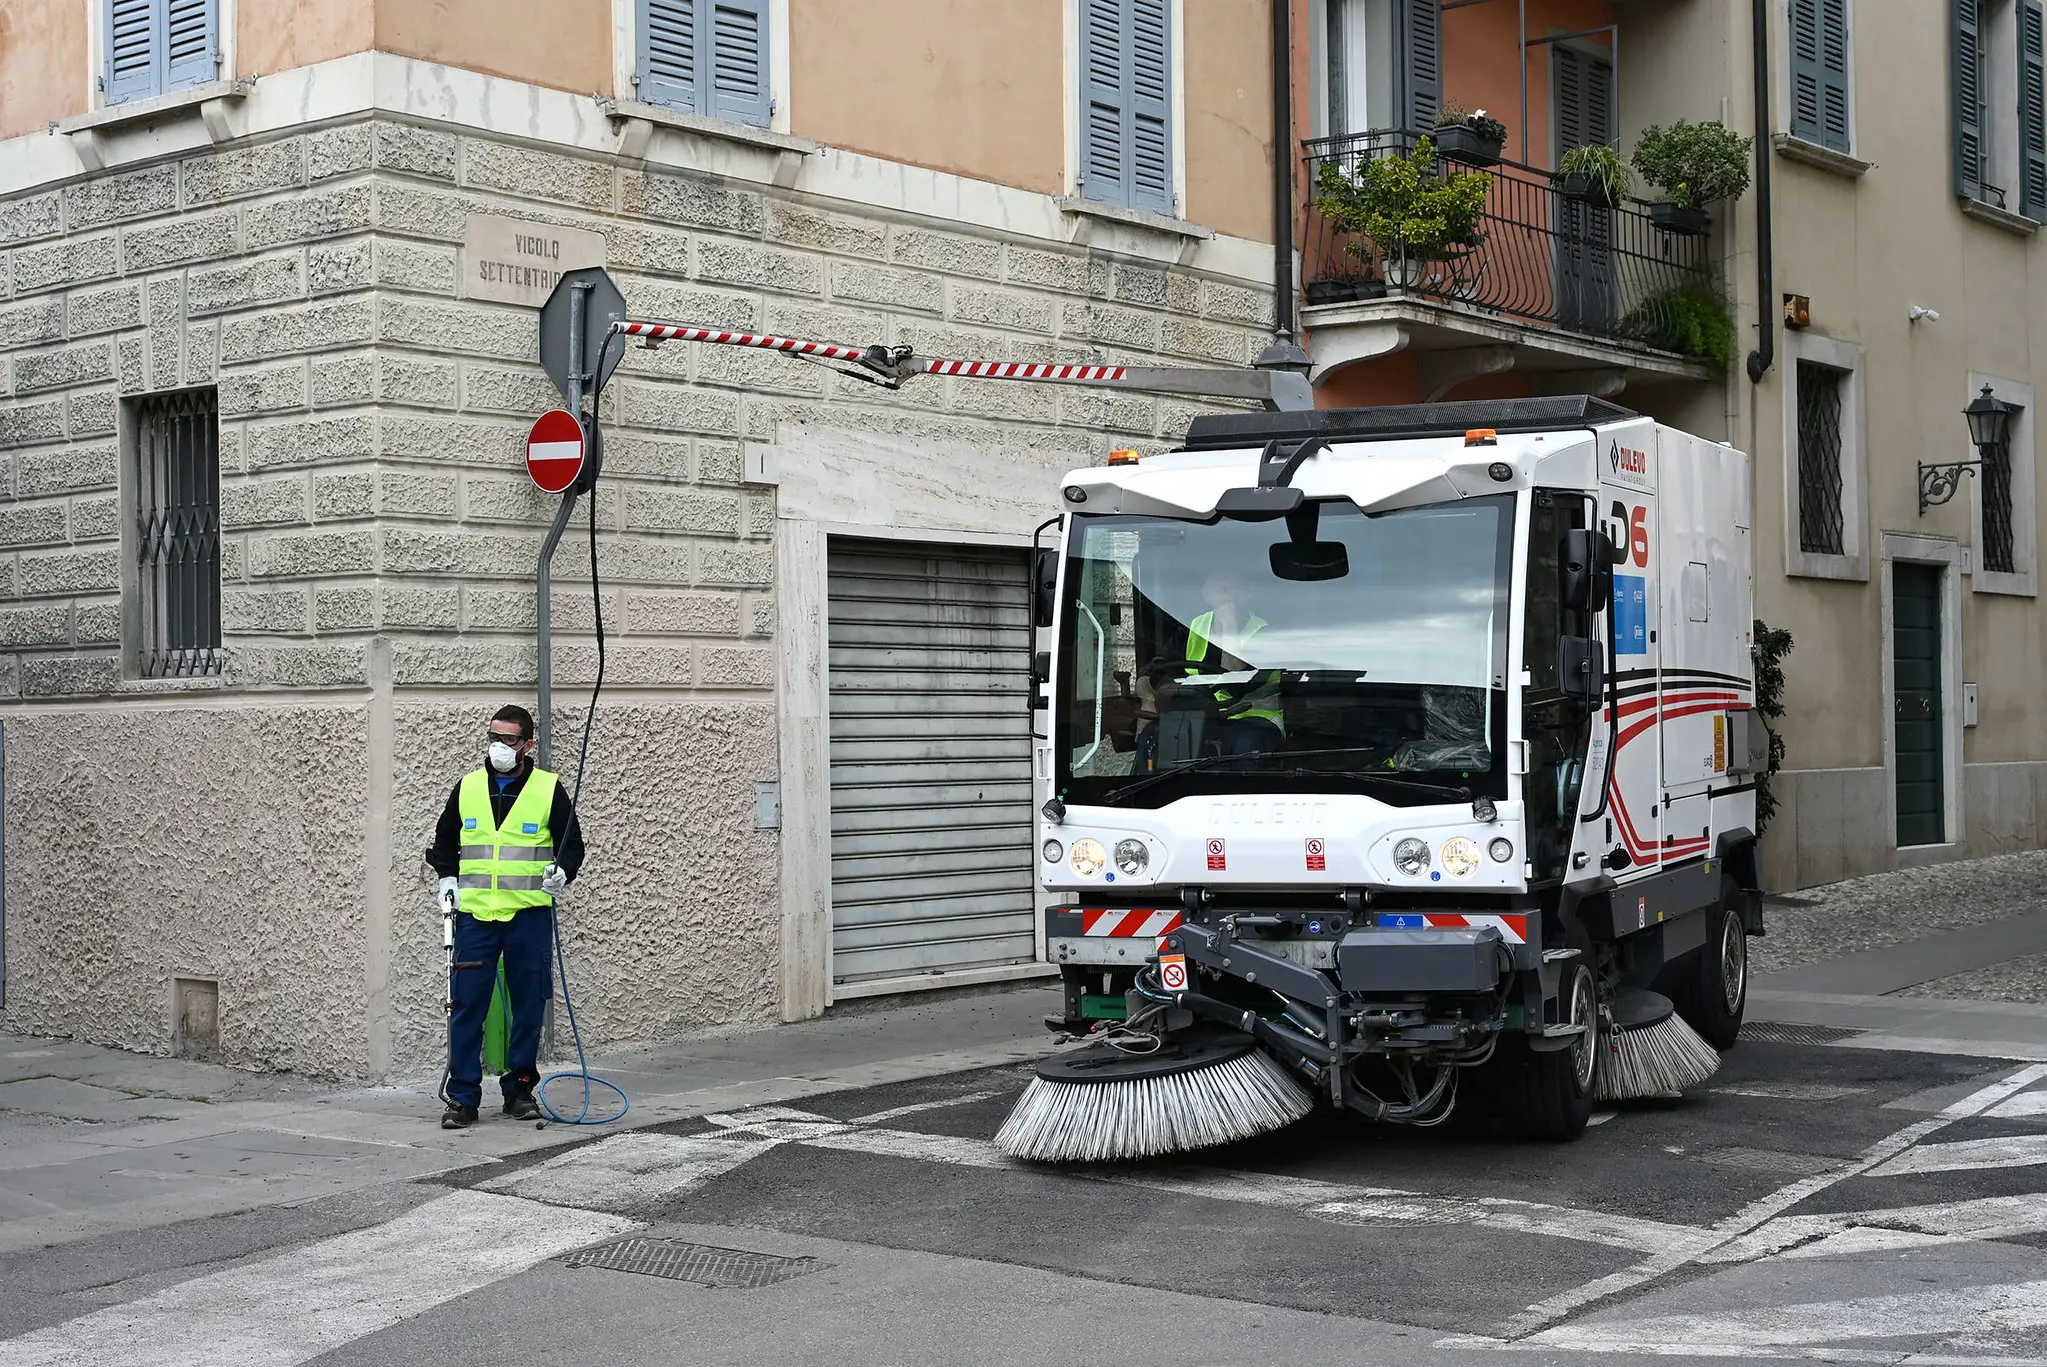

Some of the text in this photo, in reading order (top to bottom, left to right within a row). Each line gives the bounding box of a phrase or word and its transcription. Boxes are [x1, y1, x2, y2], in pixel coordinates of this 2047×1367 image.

[515, 234, 560, 260] VICOLO
[1620, 447, 1646, 474] DULEVO
[1611, 500, 1648, 568] D6
